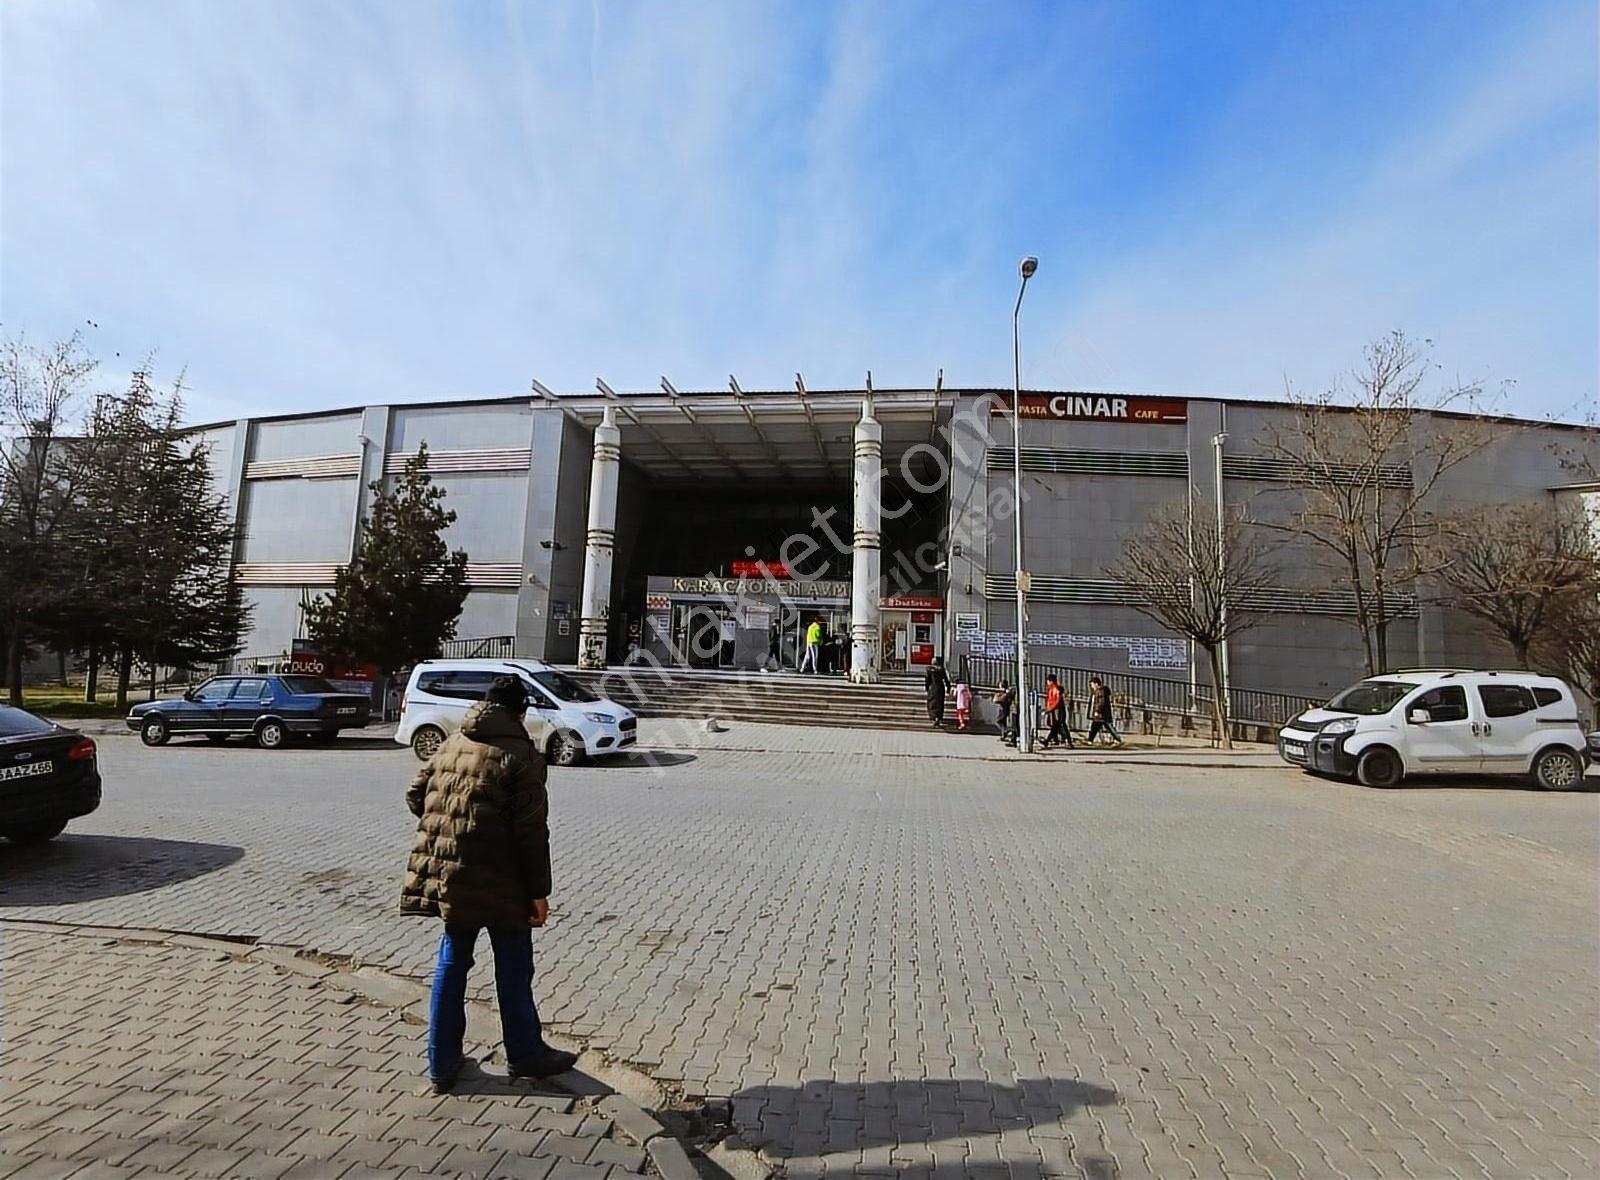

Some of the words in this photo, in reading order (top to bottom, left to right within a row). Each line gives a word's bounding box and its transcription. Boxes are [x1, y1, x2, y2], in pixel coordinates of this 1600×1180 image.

[1018, 405, 1047, 416] PASTA
[807, 581, 848, 597] AVM
[291, 659, 324, 673] pudo
